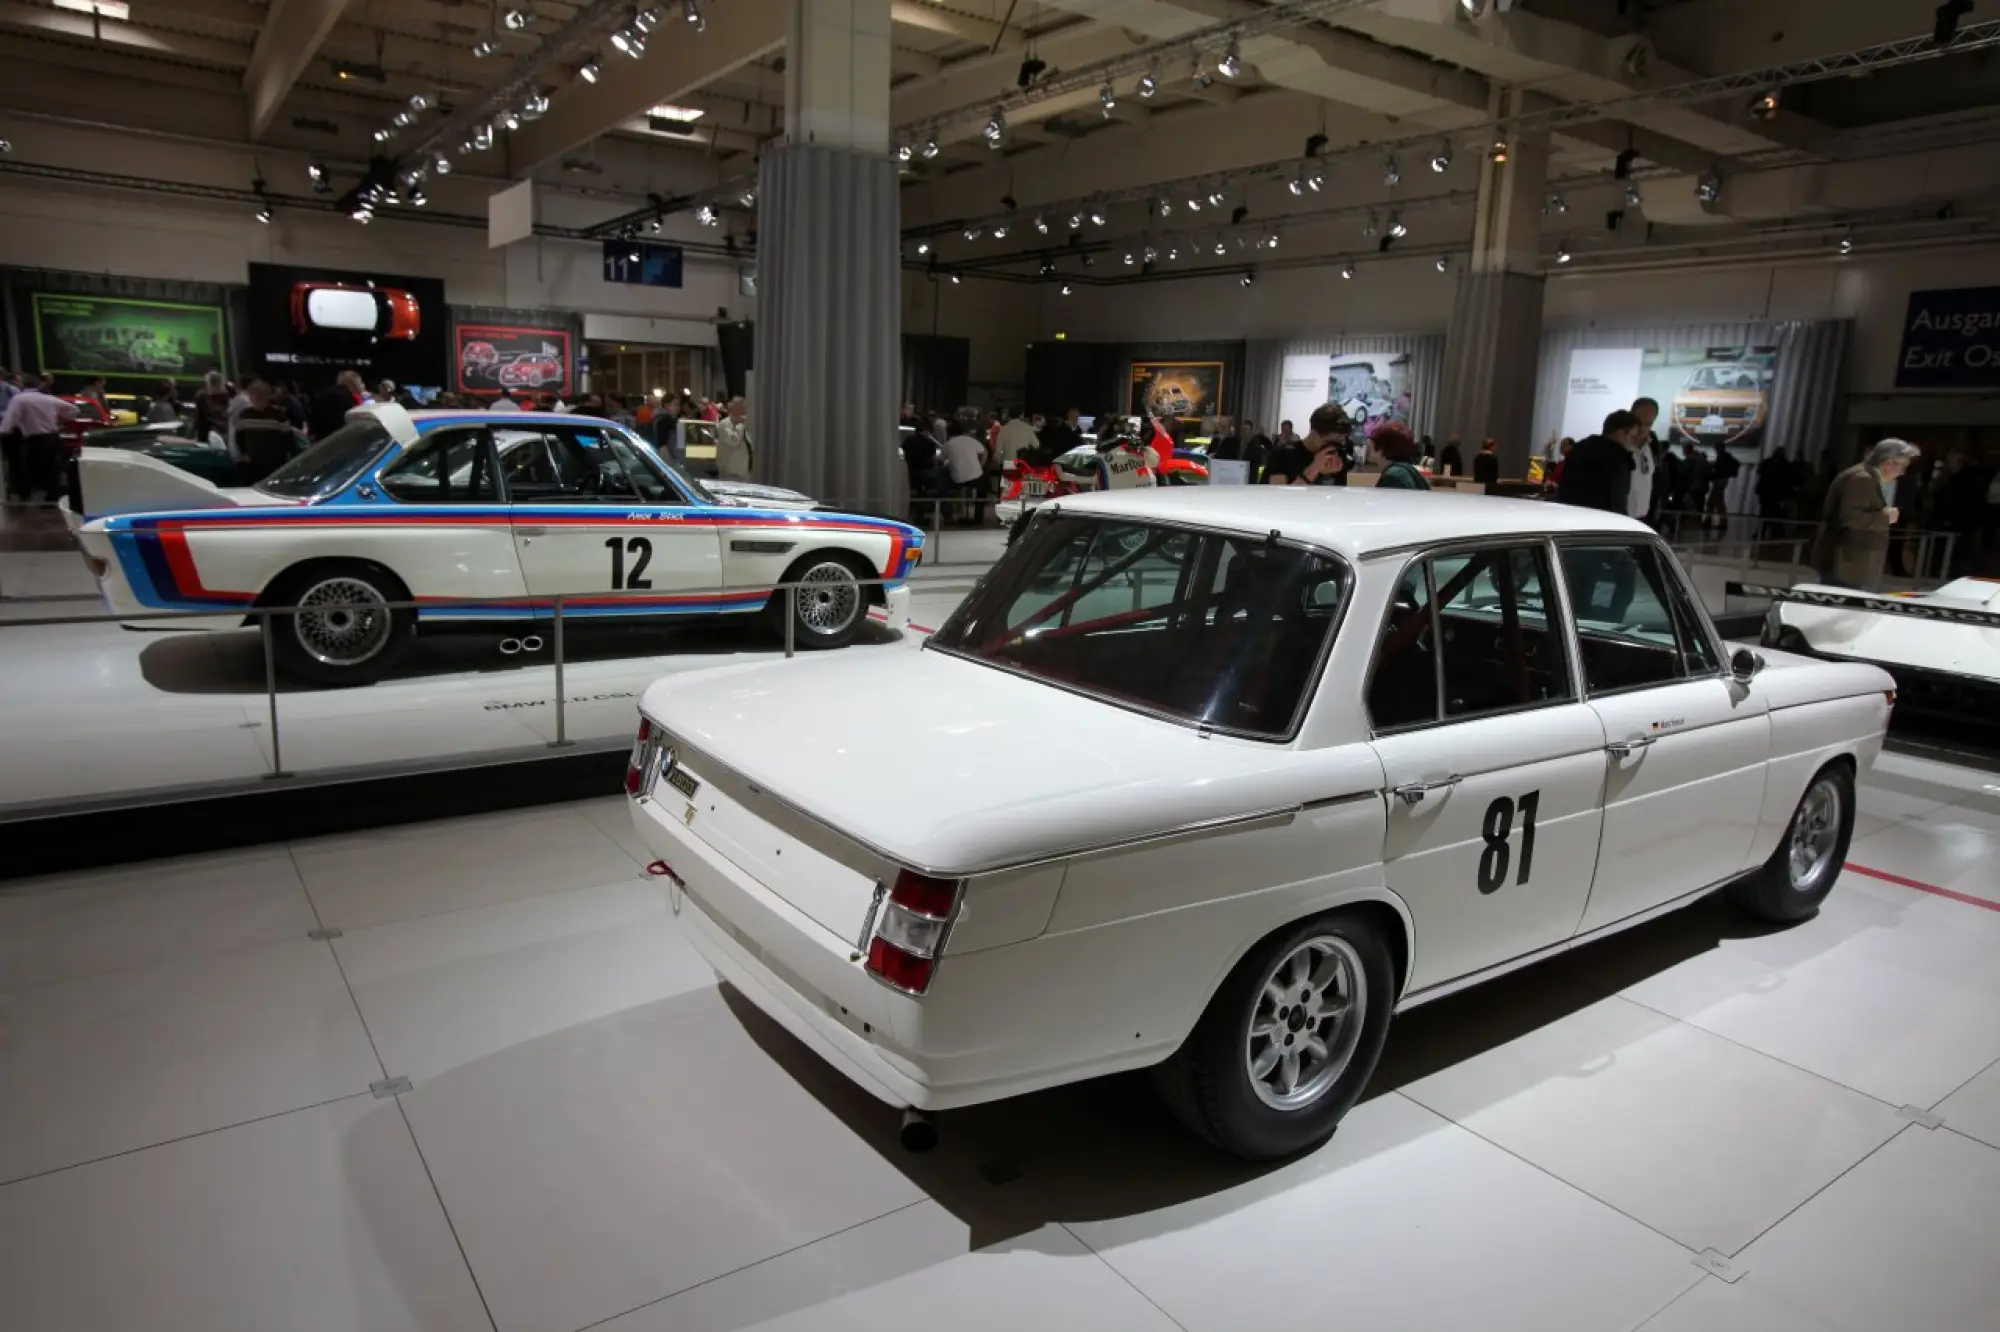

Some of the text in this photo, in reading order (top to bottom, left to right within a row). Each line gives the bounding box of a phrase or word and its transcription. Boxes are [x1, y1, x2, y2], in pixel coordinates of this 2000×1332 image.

[605, 255, 629, 281] 11
[1904, 344, 1955, 368] Exit
[605, 536, 653, 589] 12
[1742, 583, 1848, 605] BMW
[1477, 789, 1540, 895] 81
